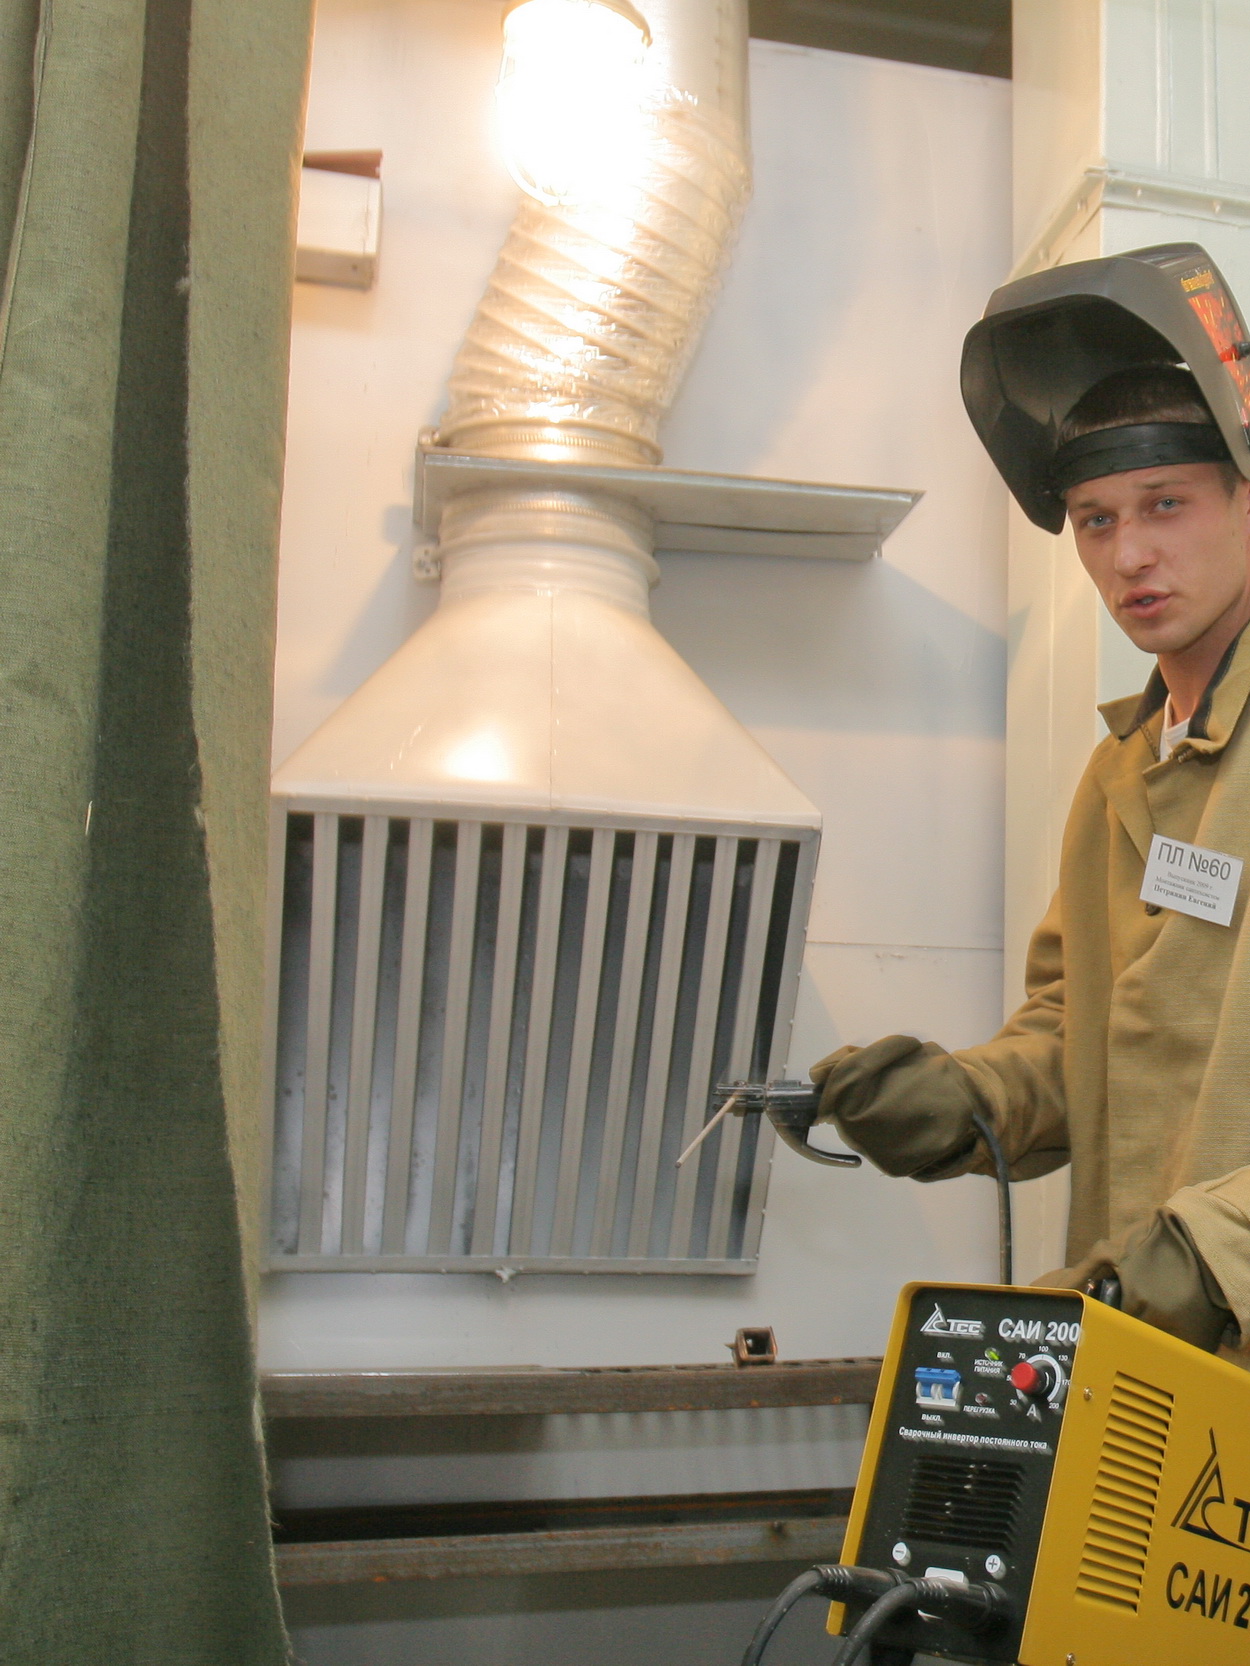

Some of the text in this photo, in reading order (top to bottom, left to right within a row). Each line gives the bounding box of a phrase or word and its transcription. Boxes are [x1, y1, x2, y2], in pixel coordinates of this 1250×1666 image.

[1158, 842, 1231, 880] ПЛ №60
[999, 1318, 1042, 1340] САИ
[1046, 1322, 1081, 1342] 200
[974, 1366, 1001, 1374] ПИТАНИЯ
[963, 1406, 995, 1415] ПЕРЕГРУЗКА
[899, 1427, 1047, 1449] Сварочный инвертор постоянного тока
[1166, 1562, 1233, 1622] САИ
